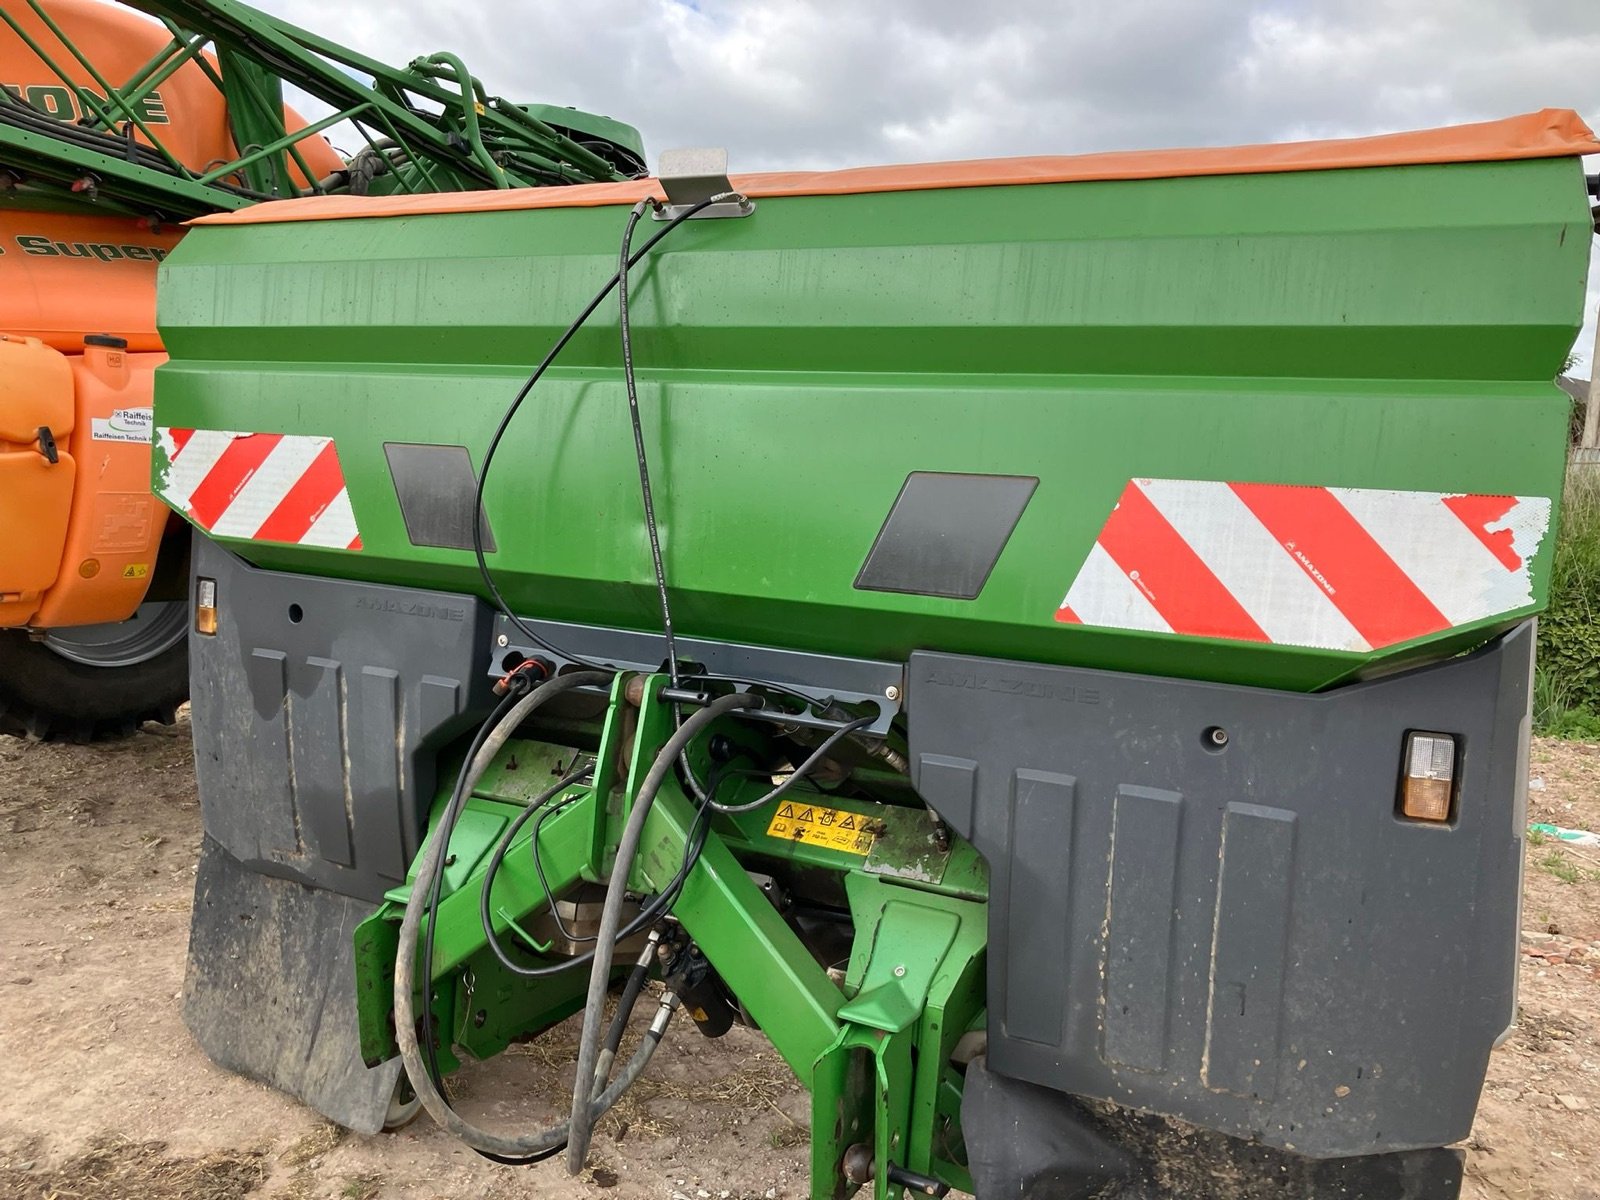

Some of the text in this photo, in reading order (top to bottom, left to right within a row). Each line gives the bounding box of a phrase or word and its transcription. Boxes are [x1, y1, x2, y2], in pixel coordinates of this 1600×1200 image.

[93, 432, 125, 440] Raiffeisen
[125, 434, 147, 442] Technik
[1295, 551, 1337, 595] AMAZONE
[356, 597, 464, 621] AMAZONE
[925, 671, 1100, 704] AMAZONE
